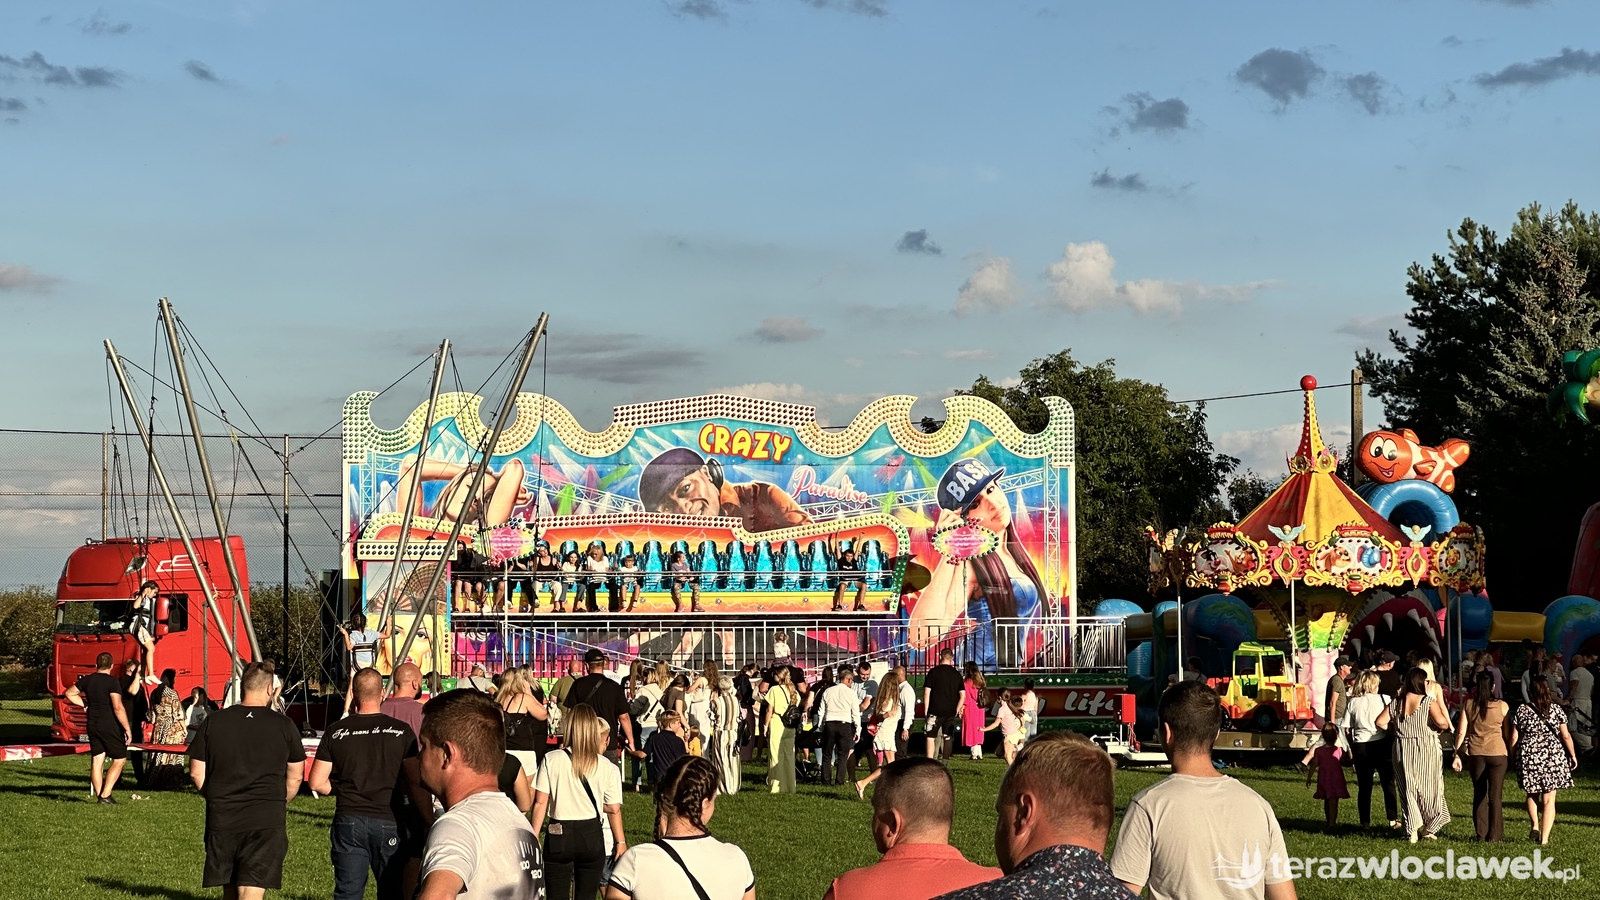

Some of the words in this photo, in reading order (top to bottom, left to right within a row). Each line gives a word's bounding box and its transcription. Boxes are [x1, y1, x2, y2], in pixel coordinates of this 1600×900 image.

[699, 423, 792, 462] CRAZY
[791, 465, 869, 504] Paradise
[530, 868, 543, 880] 120
